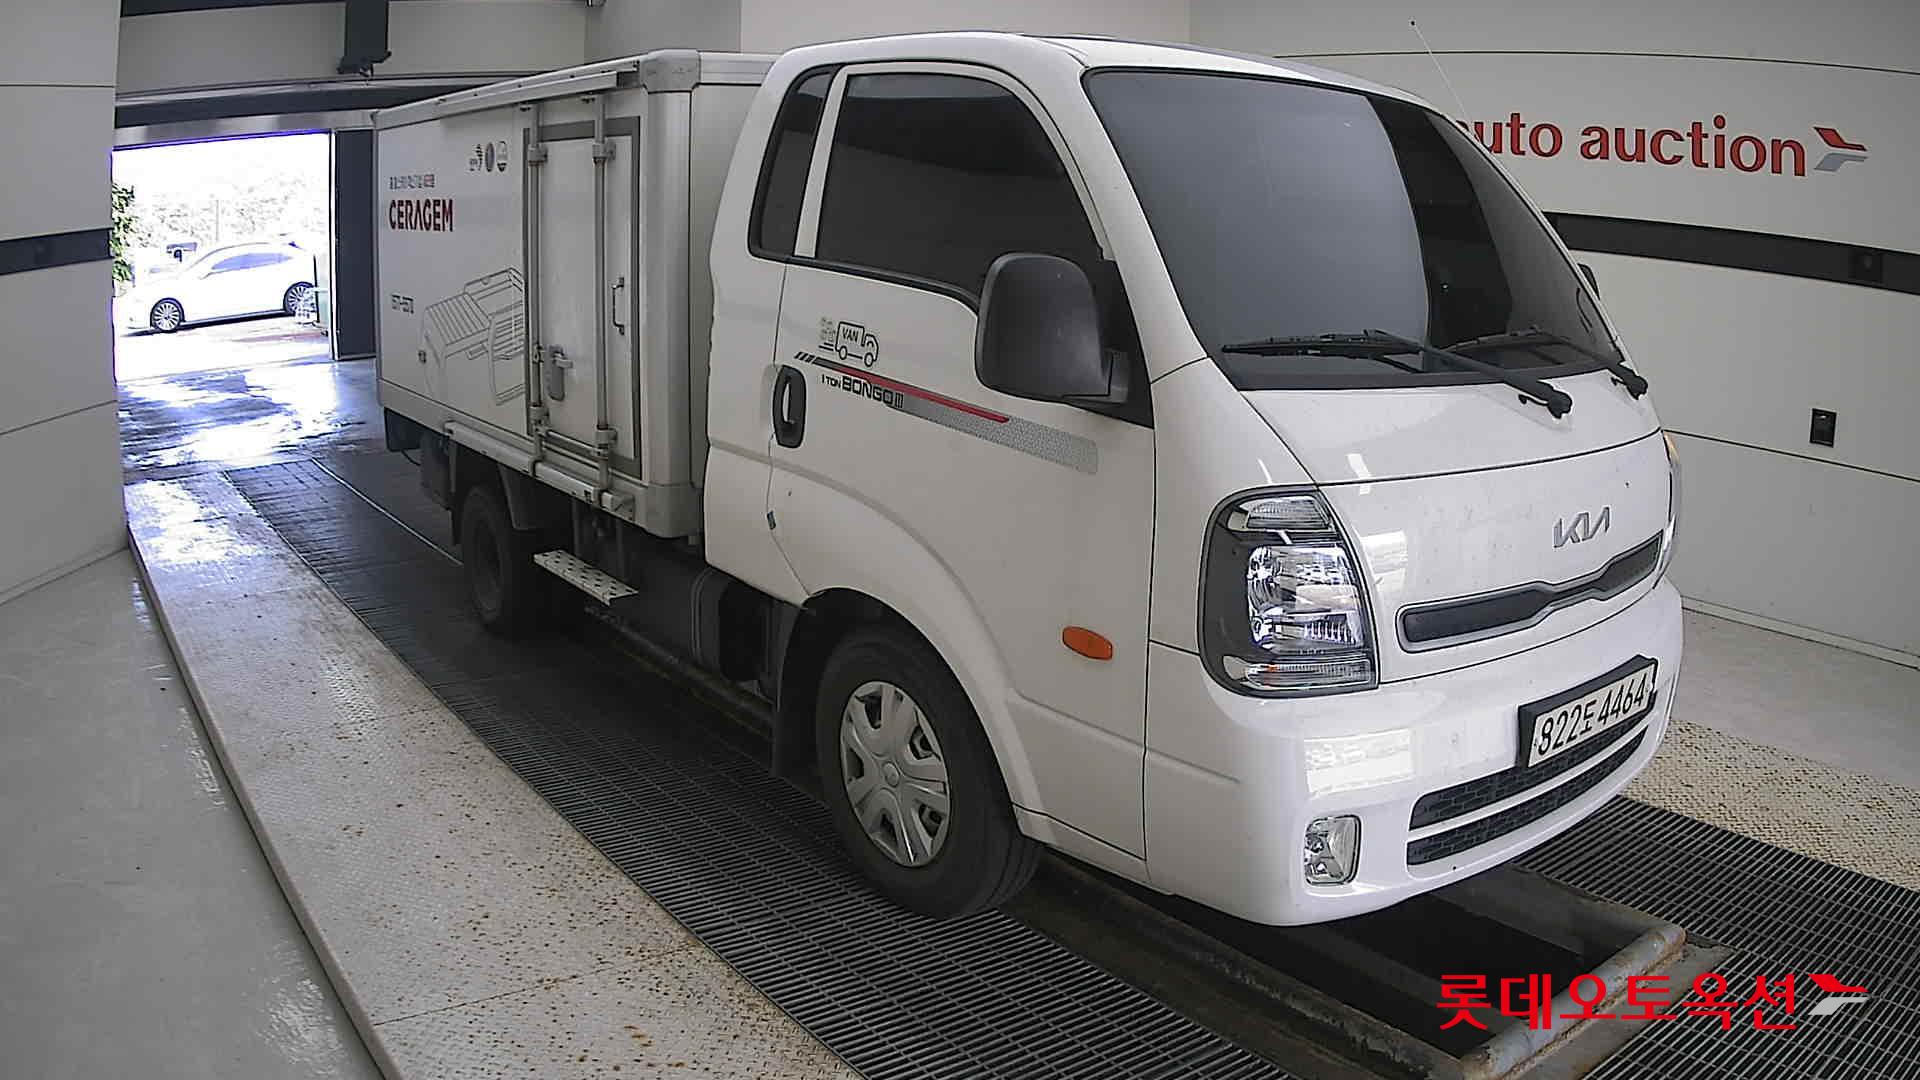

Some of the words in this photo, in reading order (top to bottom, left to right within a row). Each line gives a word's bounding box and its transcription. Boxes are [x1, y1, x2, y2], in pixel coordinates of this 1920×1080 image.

[1456, 113, 1563, 157] uto
[1580, 115, 1806, 176] auction
[388, 199, 453, 231] CERAGEM
[842, 327, 859, 342] VAN
[1553, 506, 1610, 548] KIA
